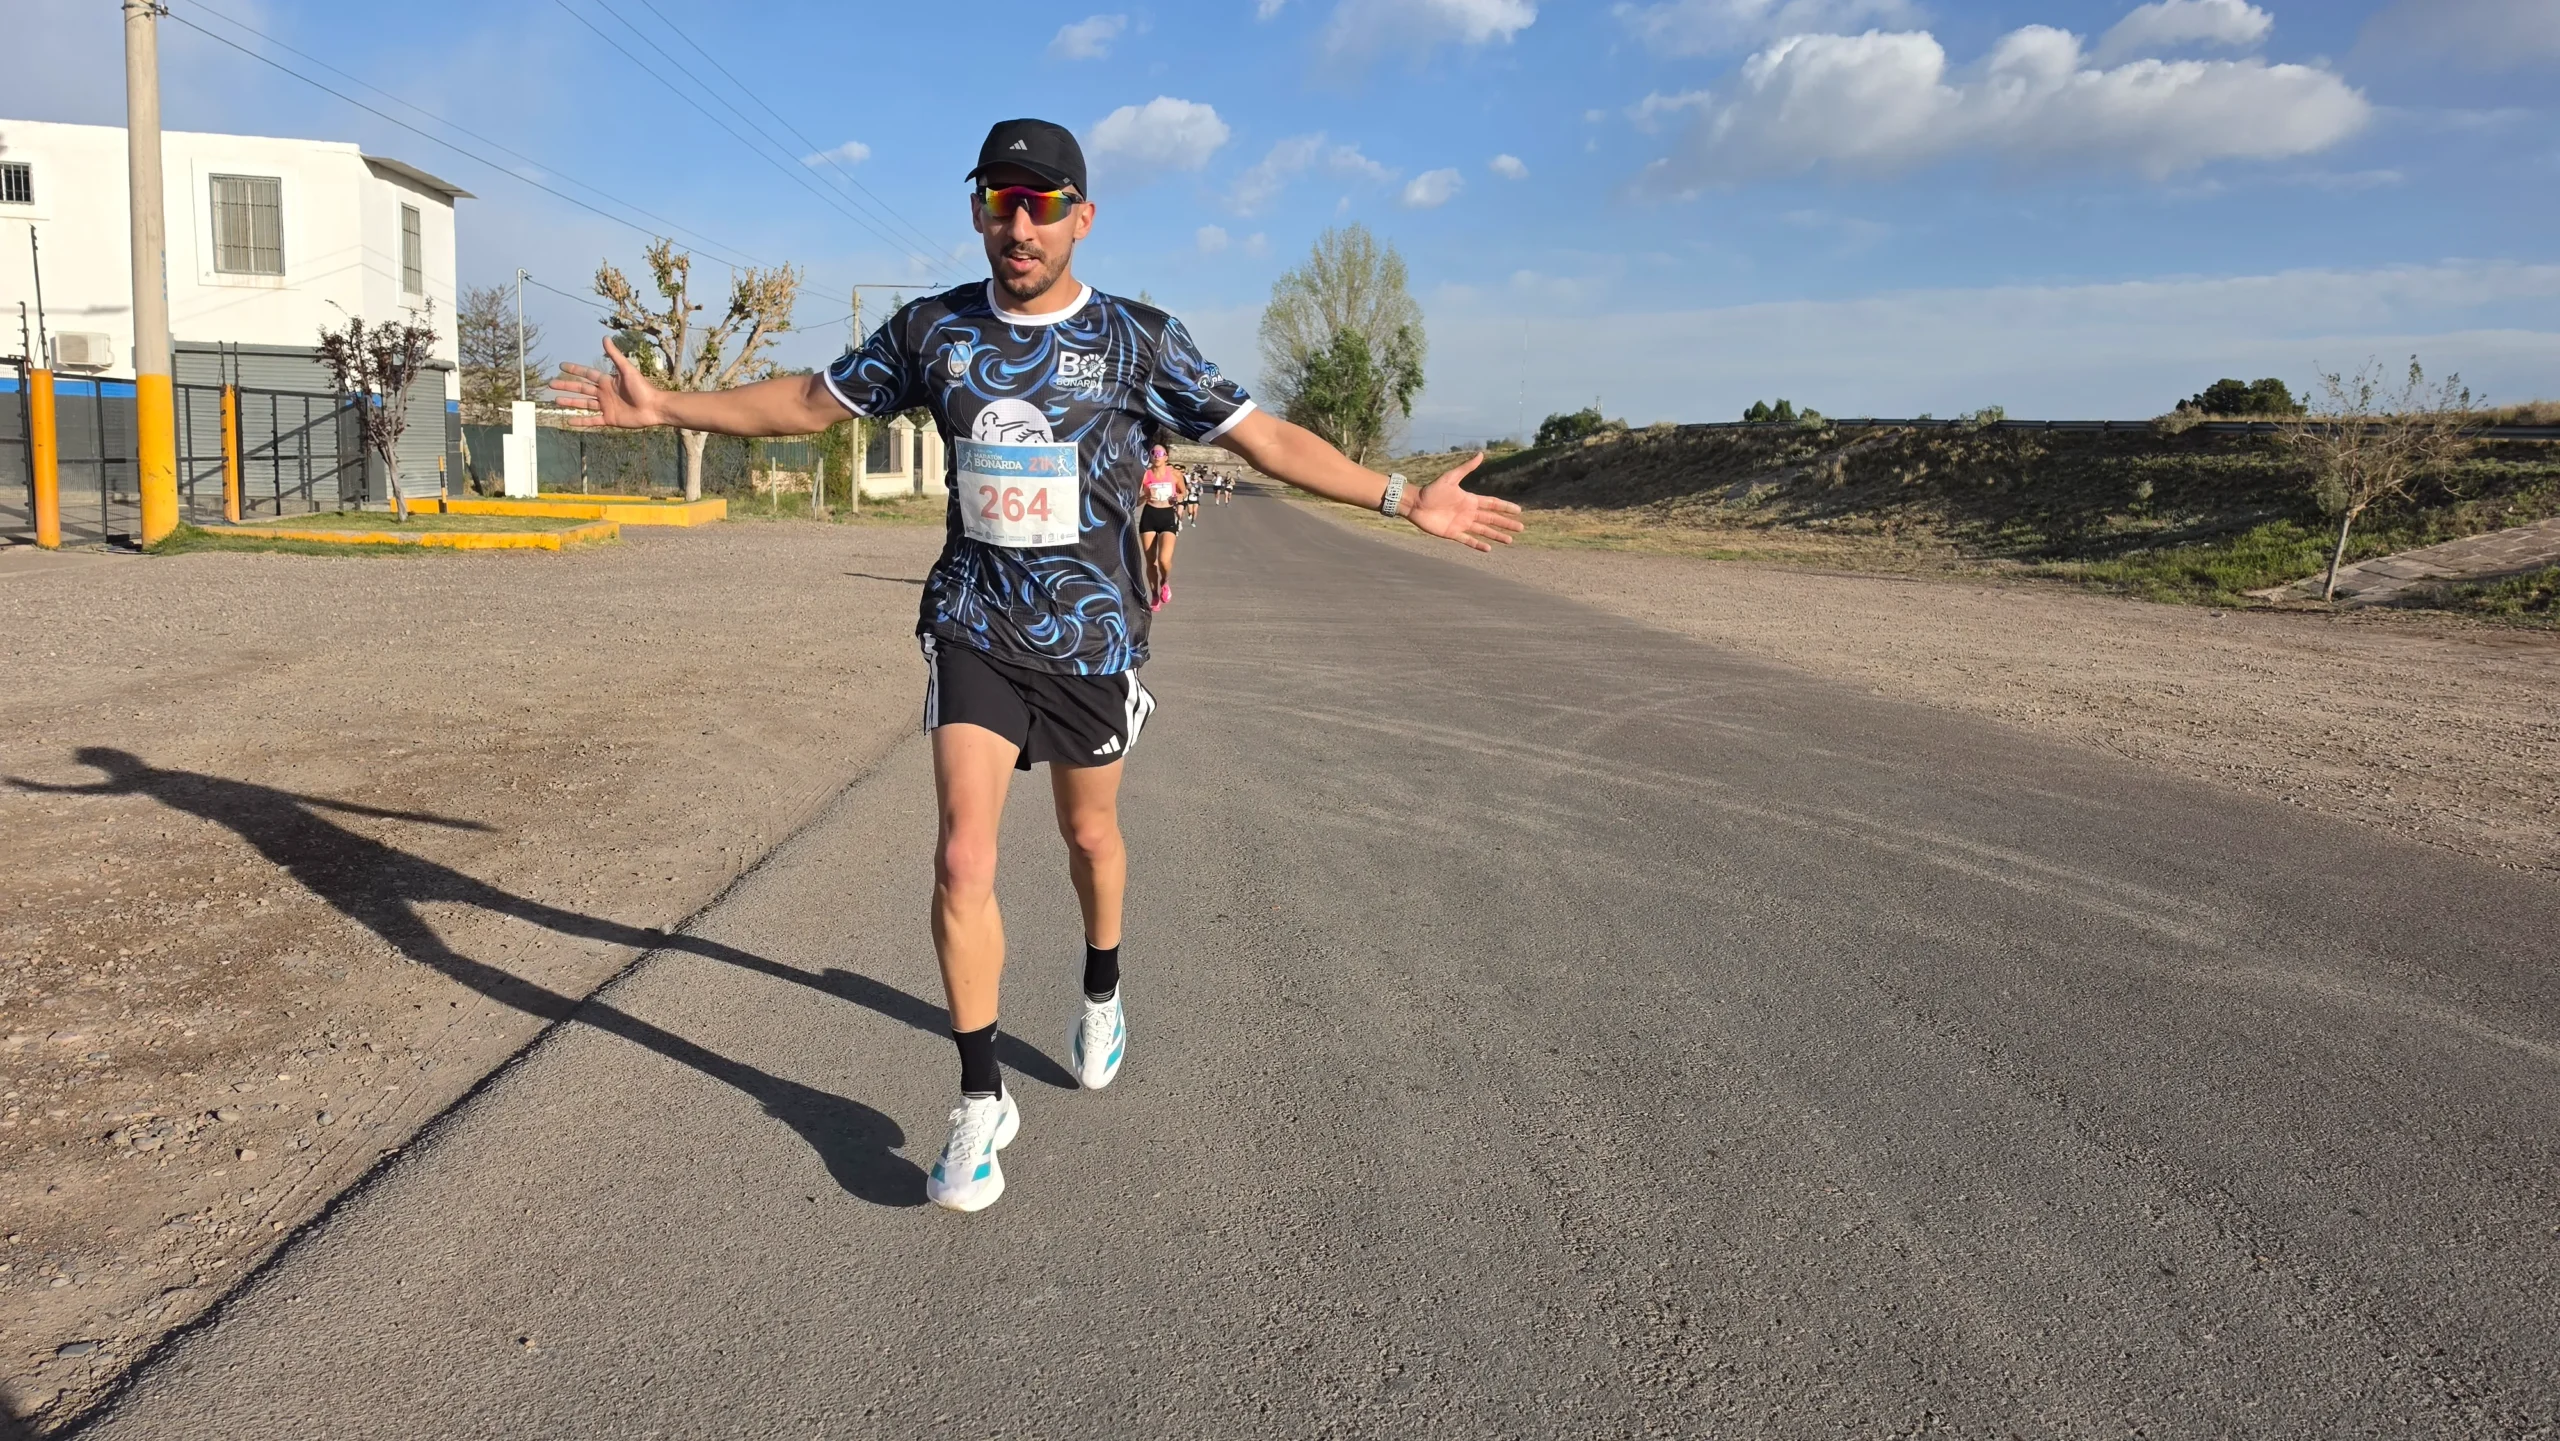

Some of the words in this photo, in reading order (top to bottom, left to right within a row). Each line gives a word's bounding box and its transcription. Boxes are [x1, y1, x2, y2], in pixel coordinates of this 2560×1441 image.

[1056, 378, 1103, 390] BONARDA
[974, 459, 1024, 471] BONARDA
[979, 485, 1052, 522] 264
